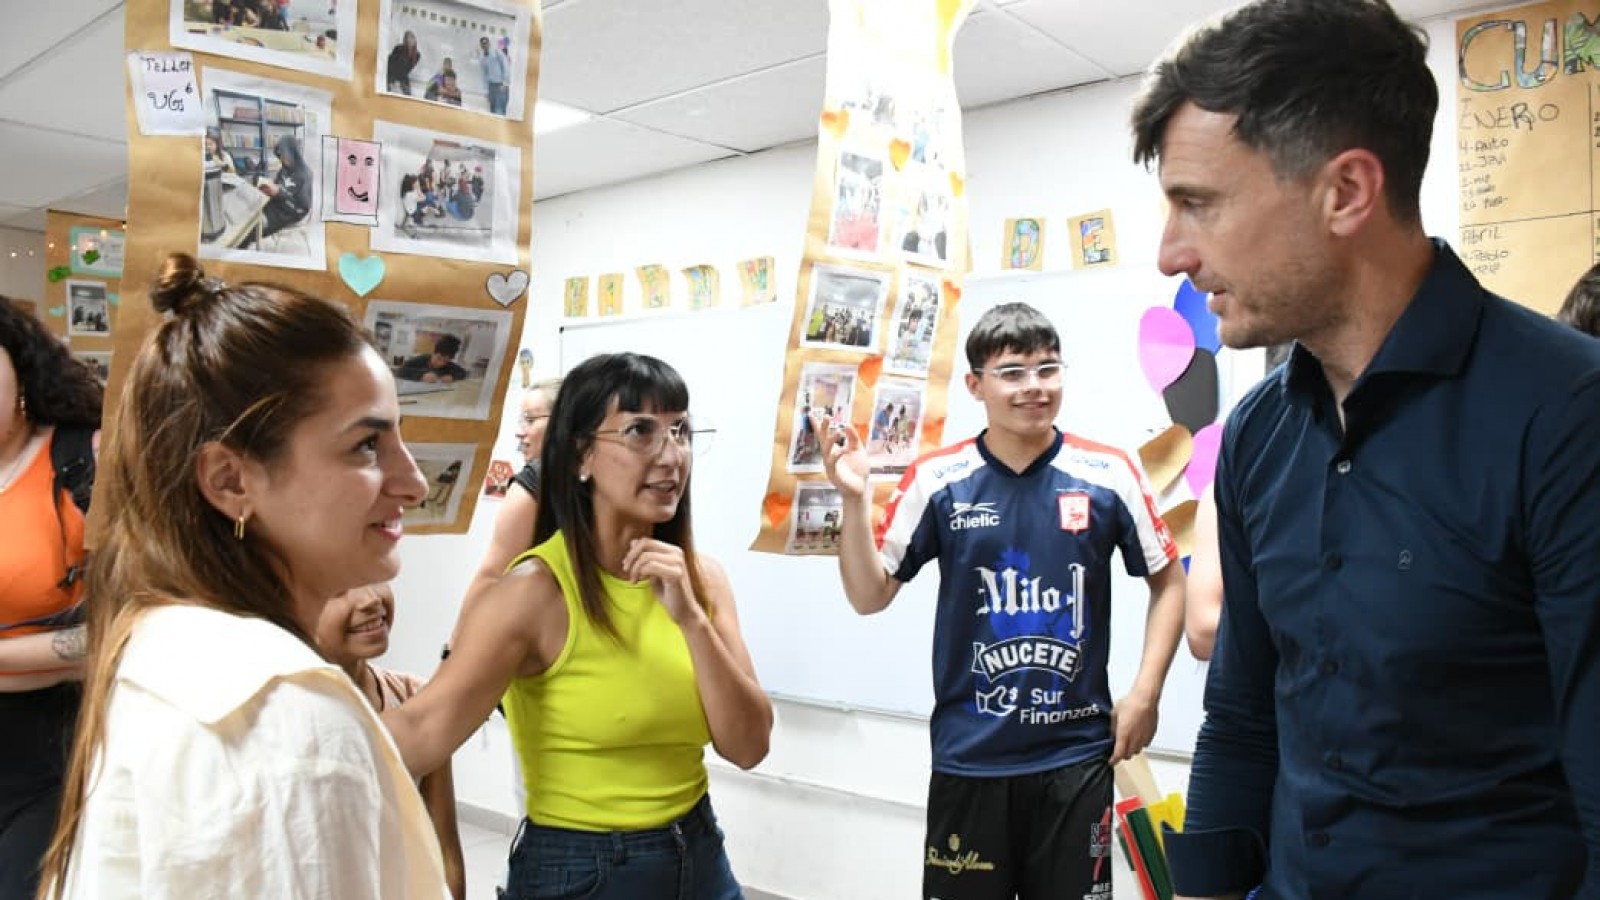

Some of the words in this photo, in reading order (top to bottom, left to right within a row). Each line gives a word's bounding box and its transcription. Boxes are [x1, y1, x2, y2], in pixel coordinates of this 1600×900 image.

[974, 566, 1060, 616] Milo
[984, 642, 1079, 674] NUCETE
[1031, 687, 1064, 706] Sur
[1020, 703, 1100, 724] Finanzas
